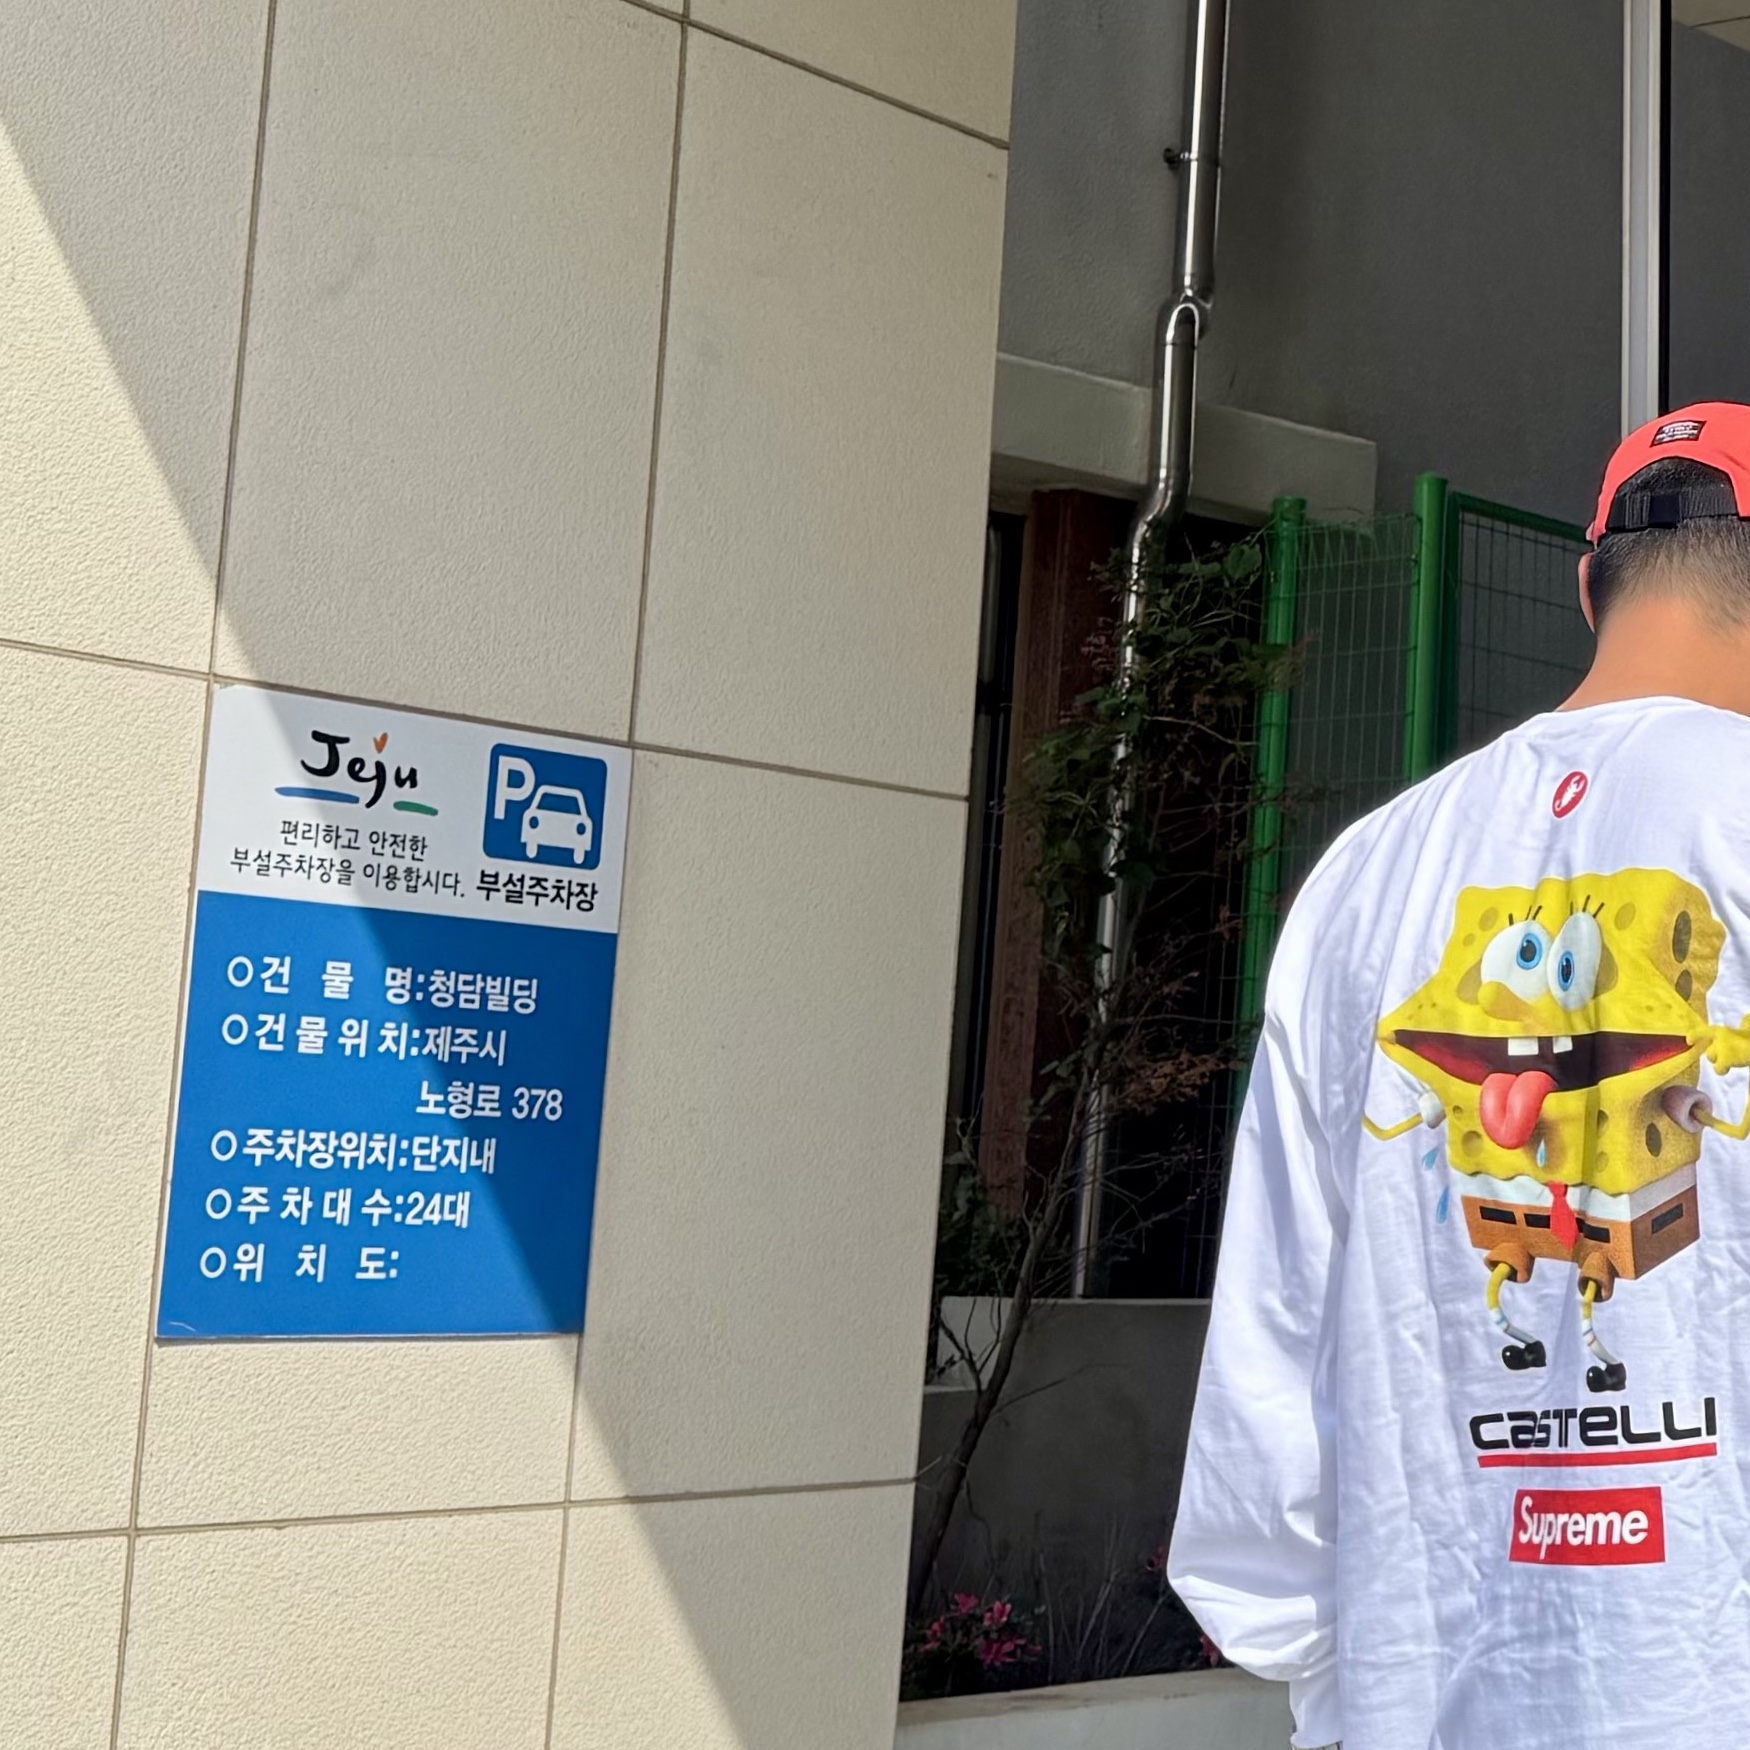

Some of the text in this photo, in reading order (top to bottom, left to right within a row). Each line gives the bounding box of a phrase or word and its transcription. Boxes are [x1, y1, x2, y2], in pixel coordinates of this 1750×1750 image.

[300, 730, 418, 808] Jeju
[279, 820, 428, 862] 편리하고 안전한
[230, 848, 466, 898] 부설주차장을 이용합시다.
[476, 869, 598, 912] 부설주차장
[415, 1080, 564, 1121] 노형로 378
[1518, 1495, 1649, 1560] Supreme
